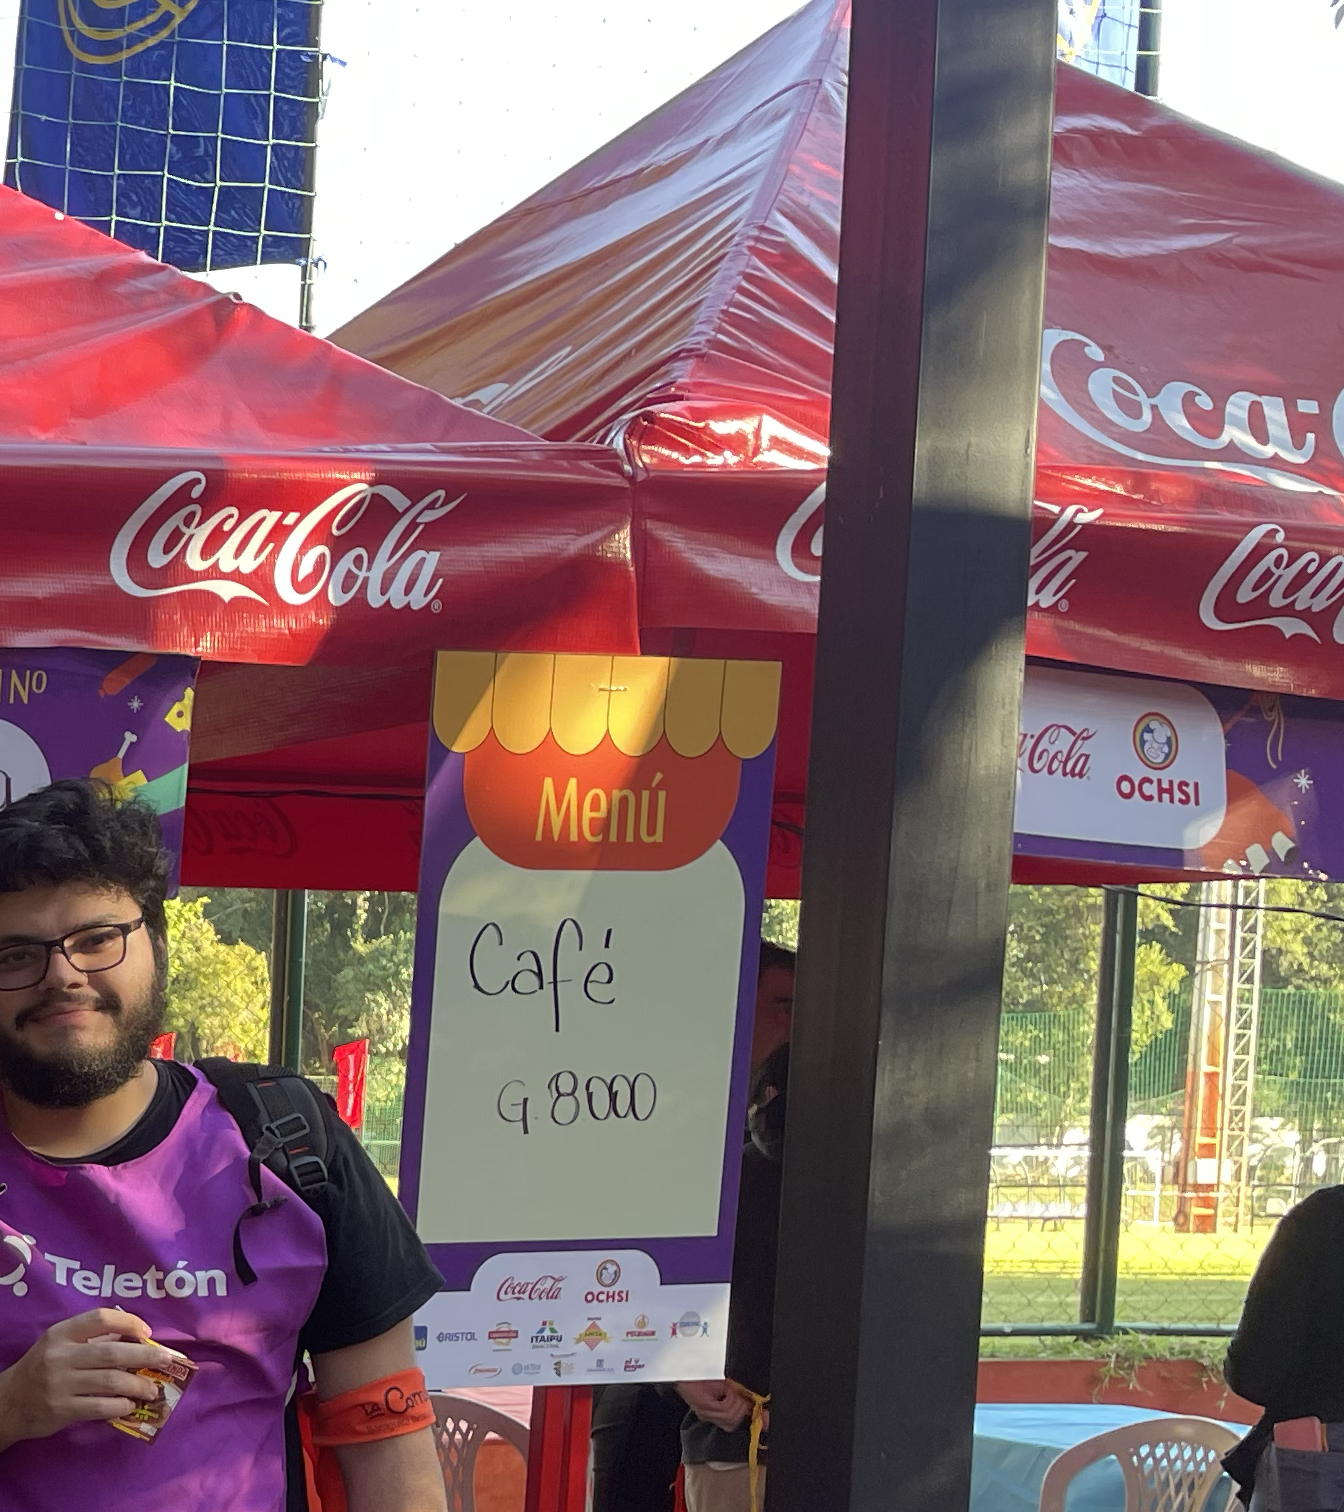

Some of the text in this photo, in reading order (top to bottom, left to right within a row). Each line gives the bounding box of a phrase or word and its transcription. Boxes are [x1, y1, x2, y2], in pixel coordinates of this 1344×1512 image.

[1037, 328, 1344, 498] Coca-
[110, 470, 468, 611] Coca-Cola
[1199, 523, 1344, 645] Coca
[534, 772, 666, 844] Menú
[1116, 775, 1200, 806] OCHSI
[469, 917, 616, 1033] Café
[44, 1252, 227, 1299] Teletón
[496, 1275, 566, 1302] Coca-Cola
[584, 1290, 629, 1304] OCHSI
[438, 1331, 478, 1342] BRISTOL
[530, 1335, 562, 1343] ITAIPU
